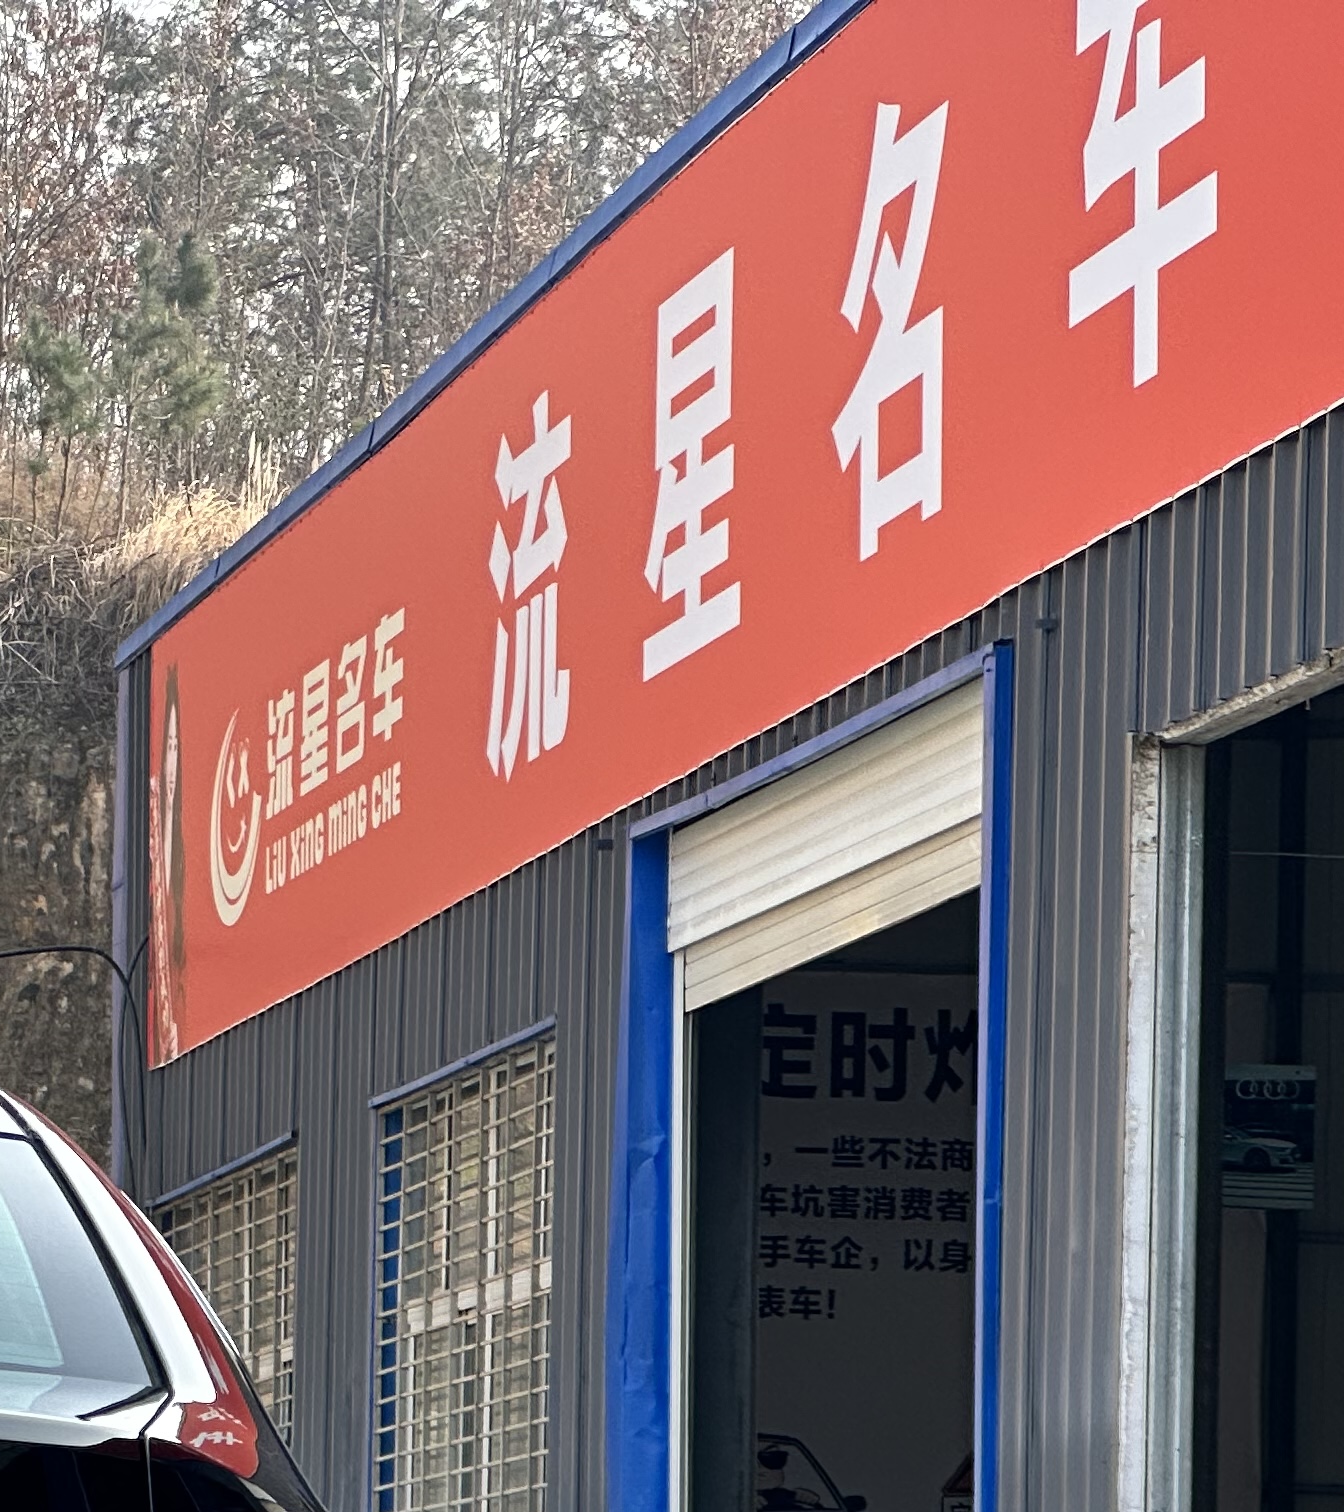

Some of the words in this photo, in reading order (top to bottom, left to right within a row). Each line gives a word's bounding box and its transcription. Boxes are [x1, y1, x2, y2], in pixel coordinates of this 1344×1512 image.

[485, 0, 1220, 782] 流星名车
[265, 607, 405, 820] 流星名车
[371, 761, 401, 829] CHE
